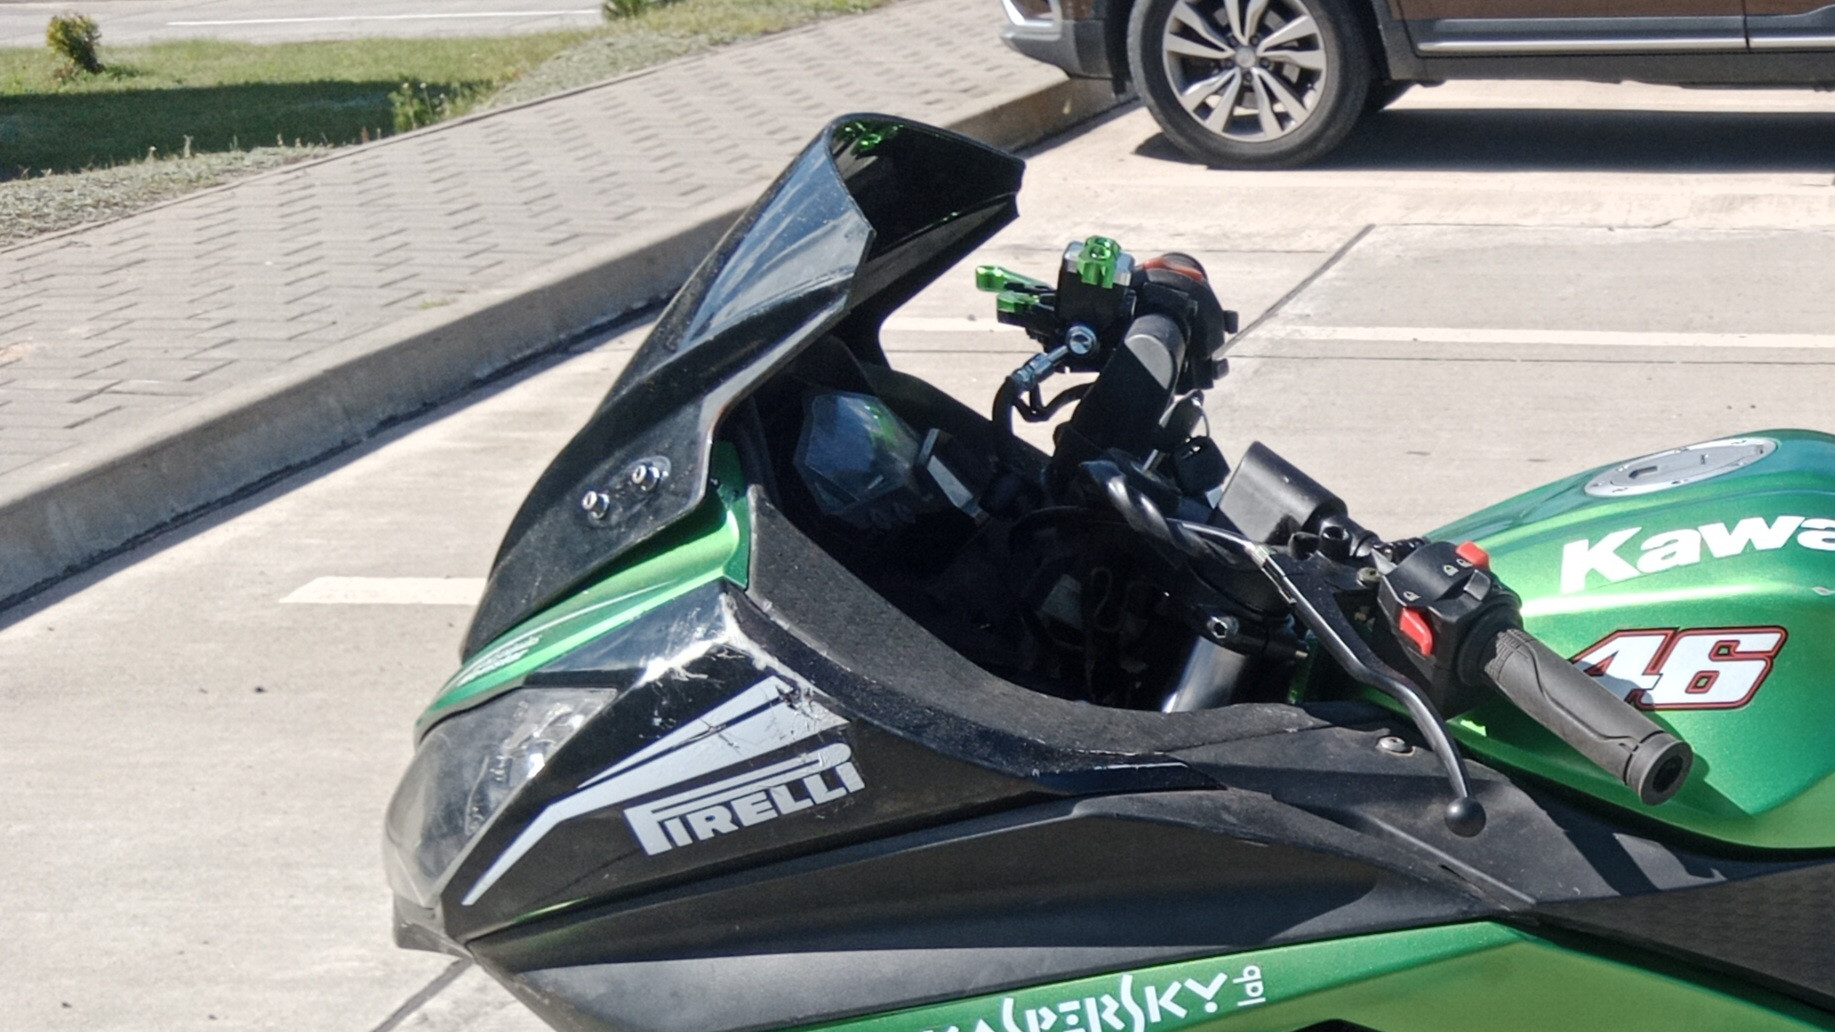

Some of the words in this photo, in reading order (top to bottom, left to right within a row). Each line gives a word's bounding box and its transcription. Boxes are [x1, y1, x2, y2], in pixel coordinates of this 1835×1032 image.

[1567, 625, 1789, 711] 46
[623, 742, 866, 856] PIRELLI
[1233, 965, 1266, 1007] lab
